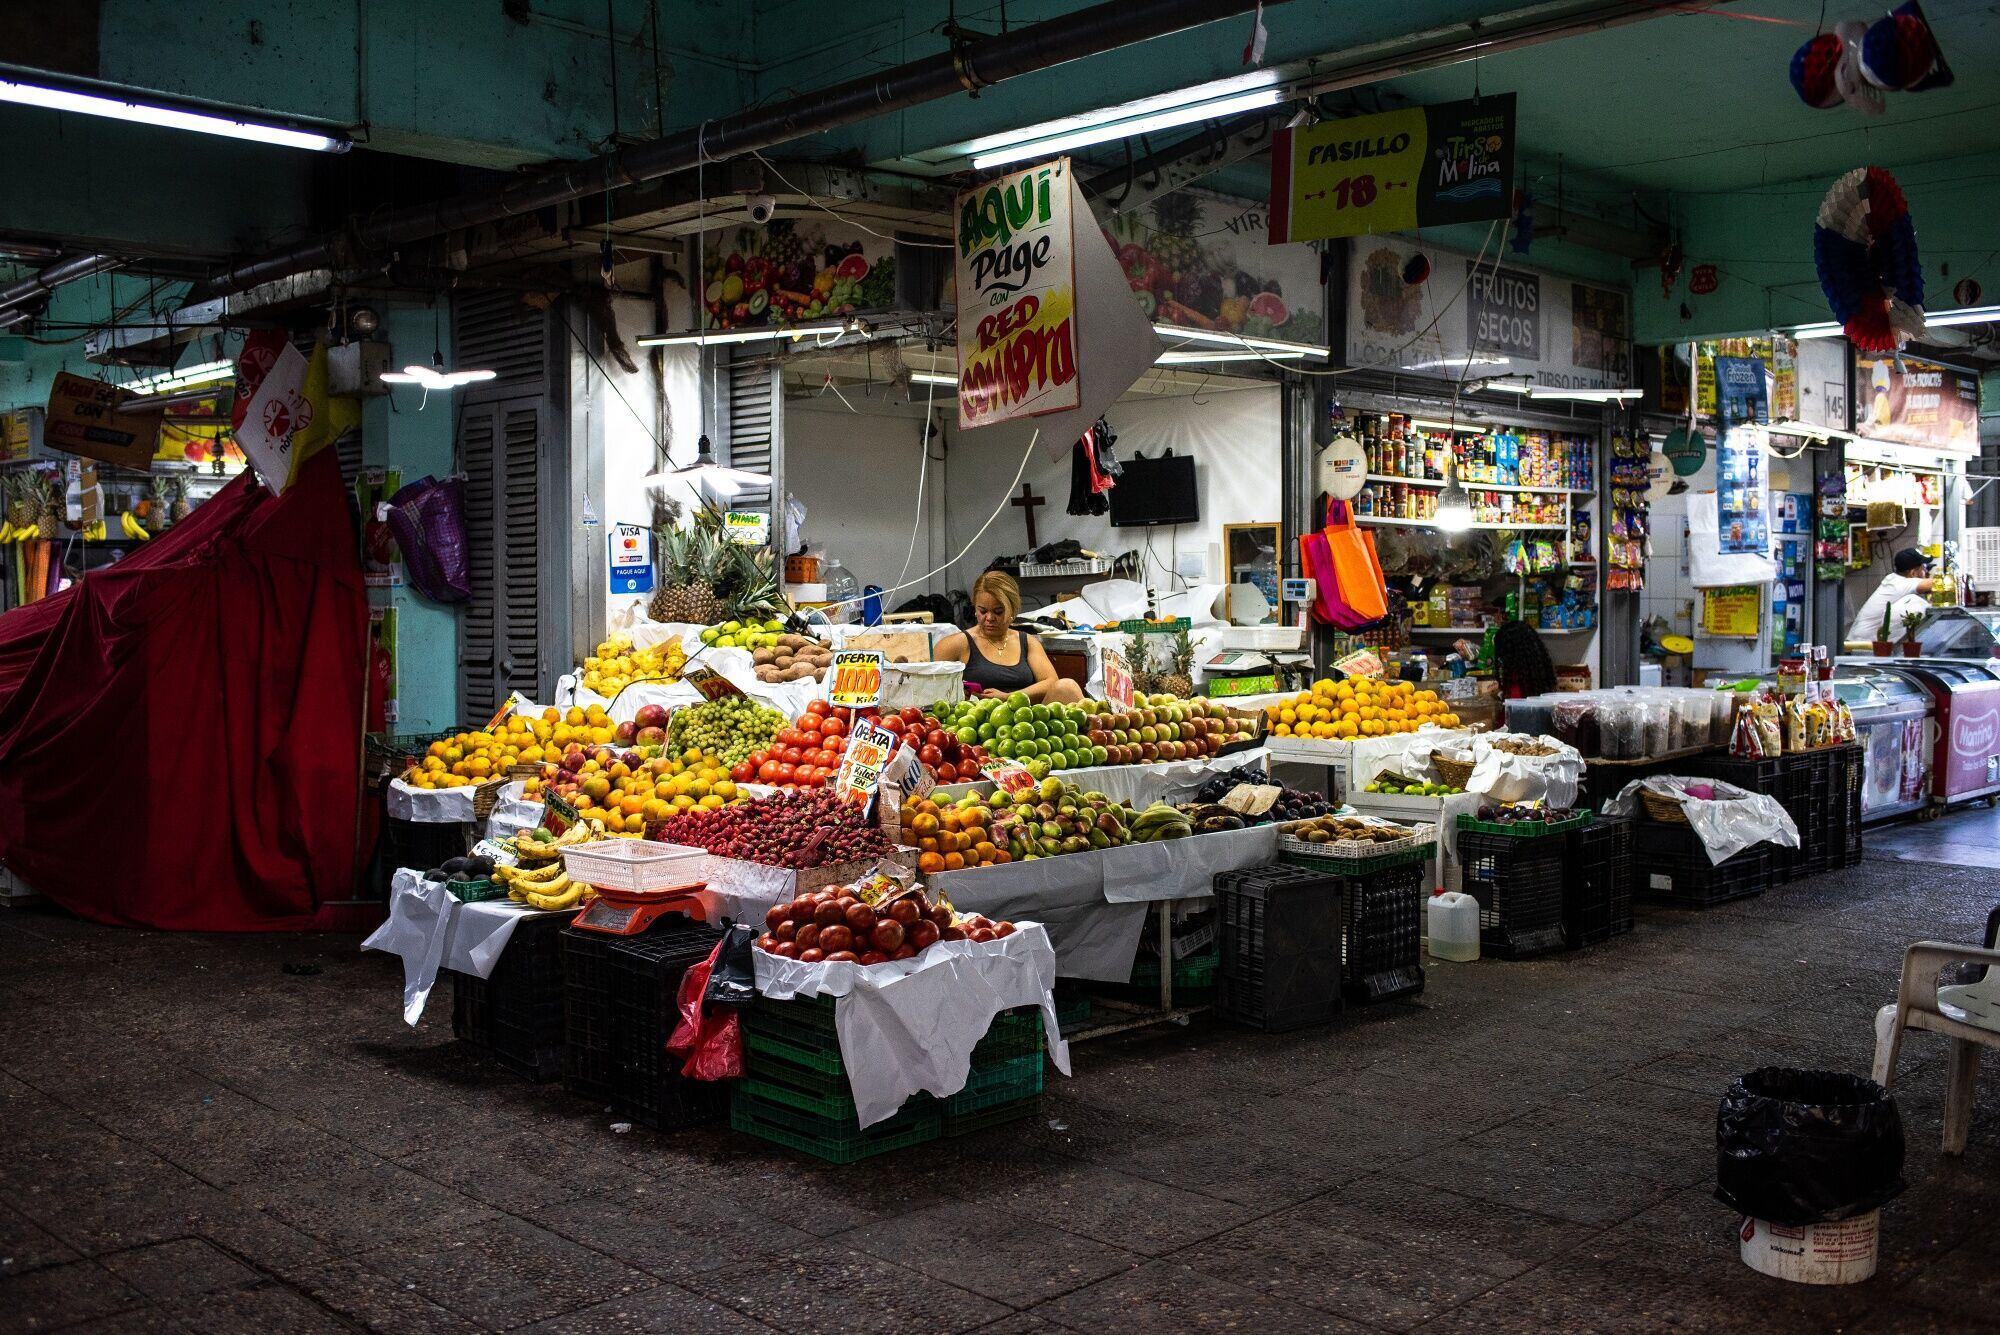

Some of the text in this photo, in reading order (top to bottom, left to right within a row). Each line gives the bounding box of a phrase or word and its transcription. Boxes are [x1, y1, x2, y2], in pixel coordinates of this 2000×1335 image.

[1461, 117, 1493, 128] MERCADO
[1474, 121, 1504, 133] ABASTOS
[1308, 132, 1411, 166] PASILLO
[1438, 154, 1500, 186] Molina
[1332, 174, 1377, 211] 18
[989, 290, 1010, 307] CON
[1472, 272, 1537, 312] FRUTOS
[976, 295, 1040, 353] RED
[1477, 310, 1533, 348] SECOS
[1537, 370, 1570, 389] TIRSO
[1572, 375, 1587, 389] DE
[1725, 367, 1757, 385] Frozen
[74, 403, 103, 419] CON
[1826, 394, 1844, 420] 145
[620, 527, 640, 537] VISA
[836, 653, 880, 665] OFERTA
[830, 668, 881, 694] 1000
[833, 694, 848, 702] EL
[854, 723, 890, 750] OFERTA
[853, 777, 866, 787] EN
